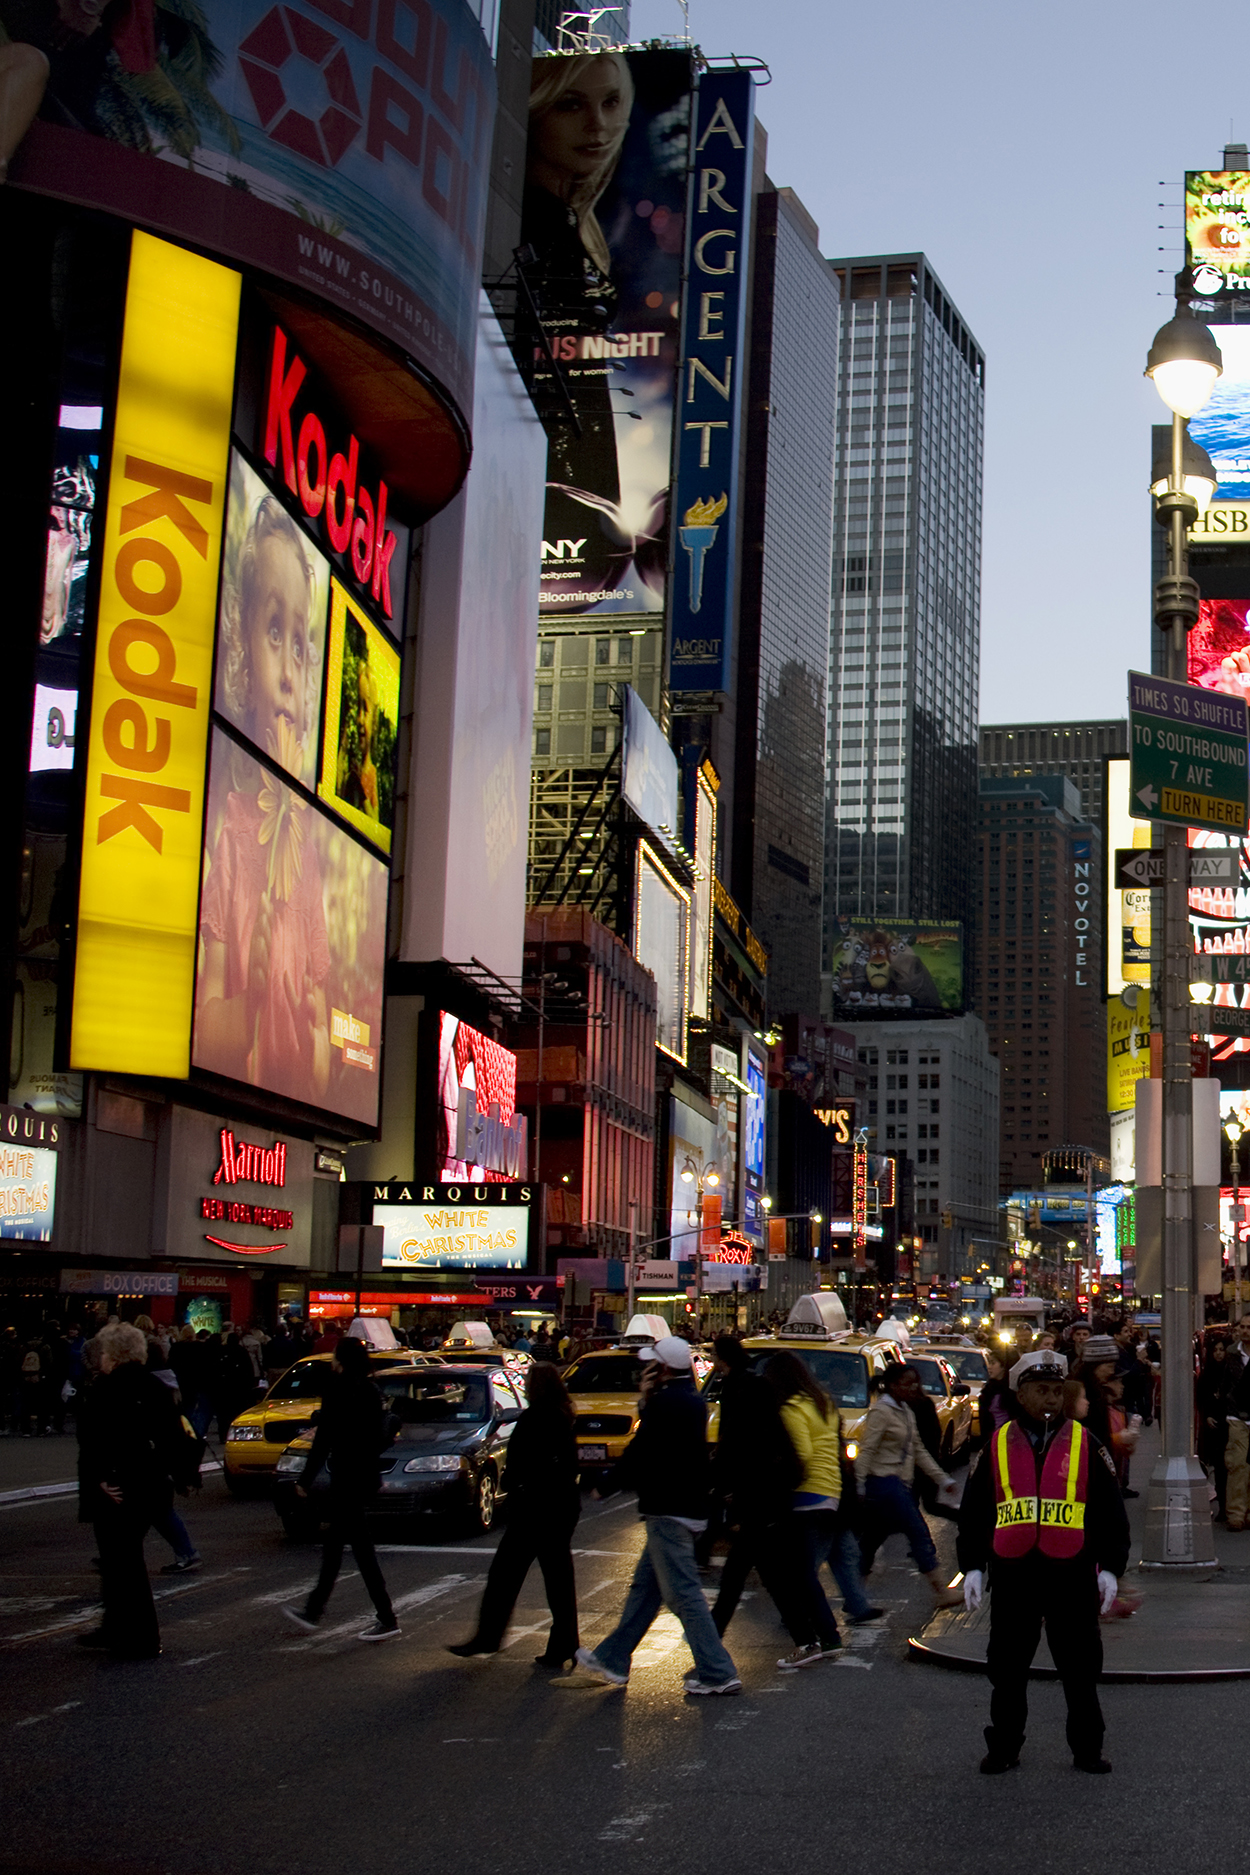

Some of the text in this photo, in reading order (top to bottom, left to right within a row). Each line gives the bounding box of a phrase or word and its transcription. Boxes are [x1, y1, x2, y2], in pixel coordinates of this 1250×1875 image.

[1220, 228, 1246, 243] for
[684, 97, 745, 468] ARGENT
[540, 318, 579, 331] roducing
[582, 332, 666, 361] NIGHT
[568, 368, 614, 377] for women
[262, 322, 397, 620] Kodak
[538, 588, 635, 604] Bloomingdale's
[97, 454, 214, 856] Kodak
[673, 636, 722, 656] ARGENT
[1133, 685, 1244, 729] TIMES SQ SHUFFLE
[1134, 724, 1246, 767] TO SOUTHBOUND
[1169, 760, 1213, 788] 7 AVE
[1164, 791, 1242, 824] TURN HERE
[1135, 860, 1165, 878] ONE
[918, 919, 939, 927] STILL
[1073, 862, 1091, 987] NOVOTEL
[1216, 957, 1230, 981] W
[333, 1014, 361, 1043] make
[1213, 1009, 1250, 1027] GEORGE
[346, 1046, 374, 1070] something
[0, 1113, 58, 1143] QUIS
[212, 1127, 288, 1187] Marriott
[373, 1186, 532, 1202] MARQUIS
[201, 1197, 225, 1221] NEW
[423, 1209, 490, 1231] WHITE
[401, 1229, 518, 1264] CHRISTMAS
[462, 1253, 494, 1261] MUSICAL
[103, 1274, 174, 1293] BOX OFFICE
[182, 1275, 228, 1287] THE MUSICAL
[642, 1272, 675, 1281] TISHMAN
[480, 1286, 517, 1299] TERS
[792, 1323, 815, 1334] 9V67
[998, 1500, 1073, 1526] TRAFFIC
